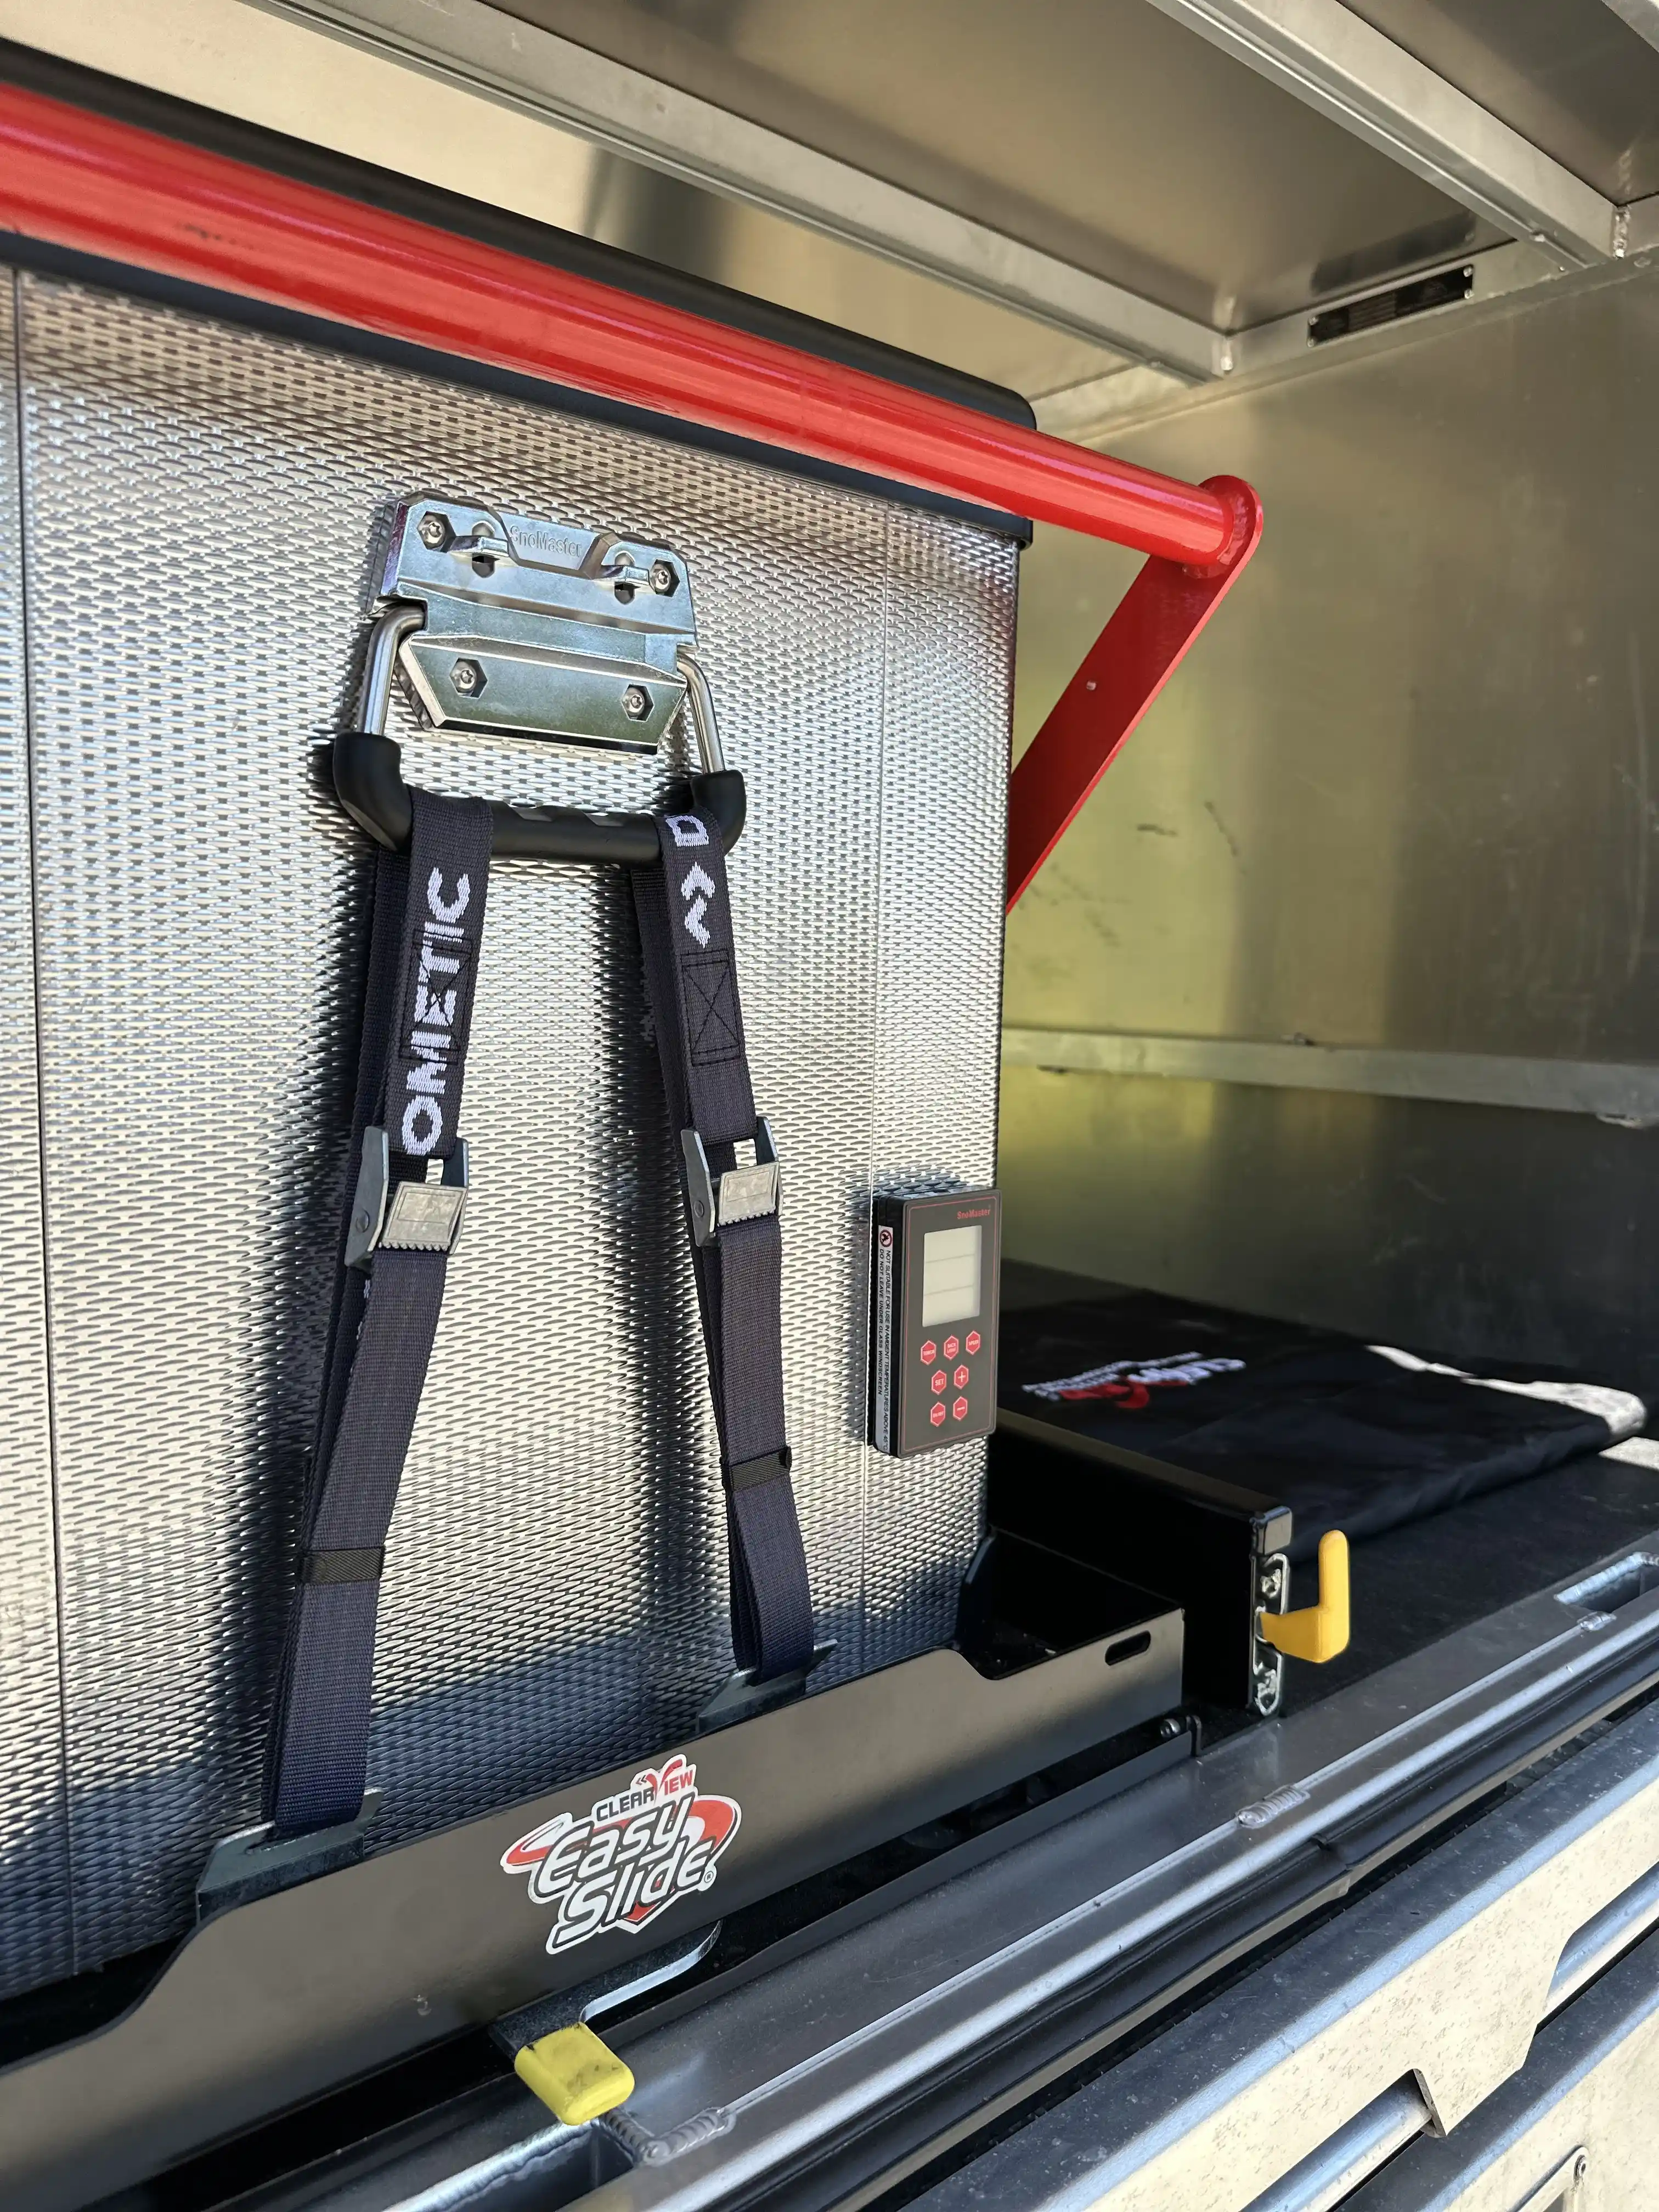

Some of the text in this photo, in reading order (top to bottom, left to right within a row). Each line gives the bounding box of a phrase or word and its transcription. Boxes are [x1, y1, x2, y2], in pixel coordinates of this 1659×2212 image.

[510, 524, 583, 558] SnoMaster
[957, 1209, 991, 1219] SnoMaster
[879, 1249, 884, 1259] DO
